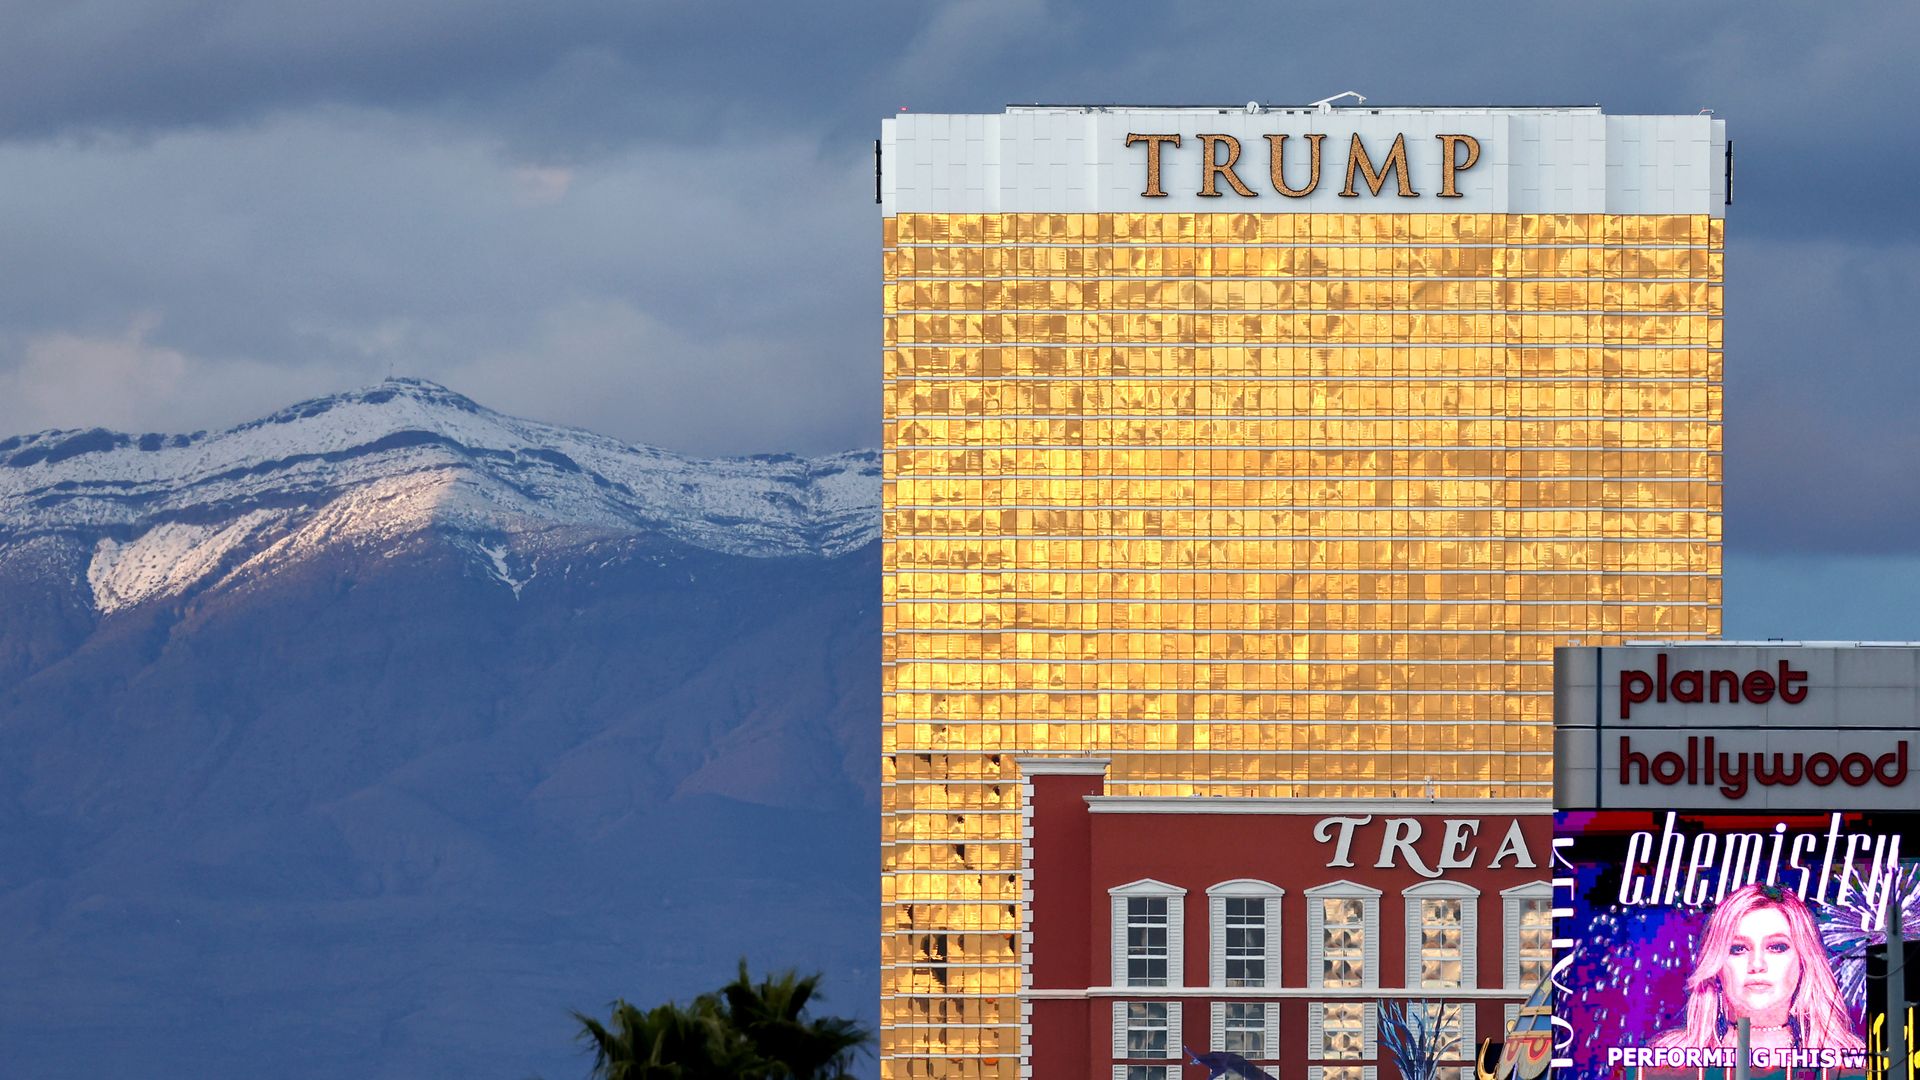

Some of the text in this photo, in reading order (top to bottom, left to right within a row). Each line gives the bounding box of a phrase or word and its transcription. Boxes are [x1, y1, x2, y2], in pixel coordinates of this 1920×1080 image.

[1126, 132, 1481, 198] TRUMP
[1619, 653, 1809, 720] planet
[1619, 735, 1909, 800] hollywood
[1313, 814, 1553, 878] TREA
[1618, 811, 1901, 932] chemistry
[1607, 1047, 1770, 1069] PERFORMIG
[1774, 1048, 1836, 1069] THIS
